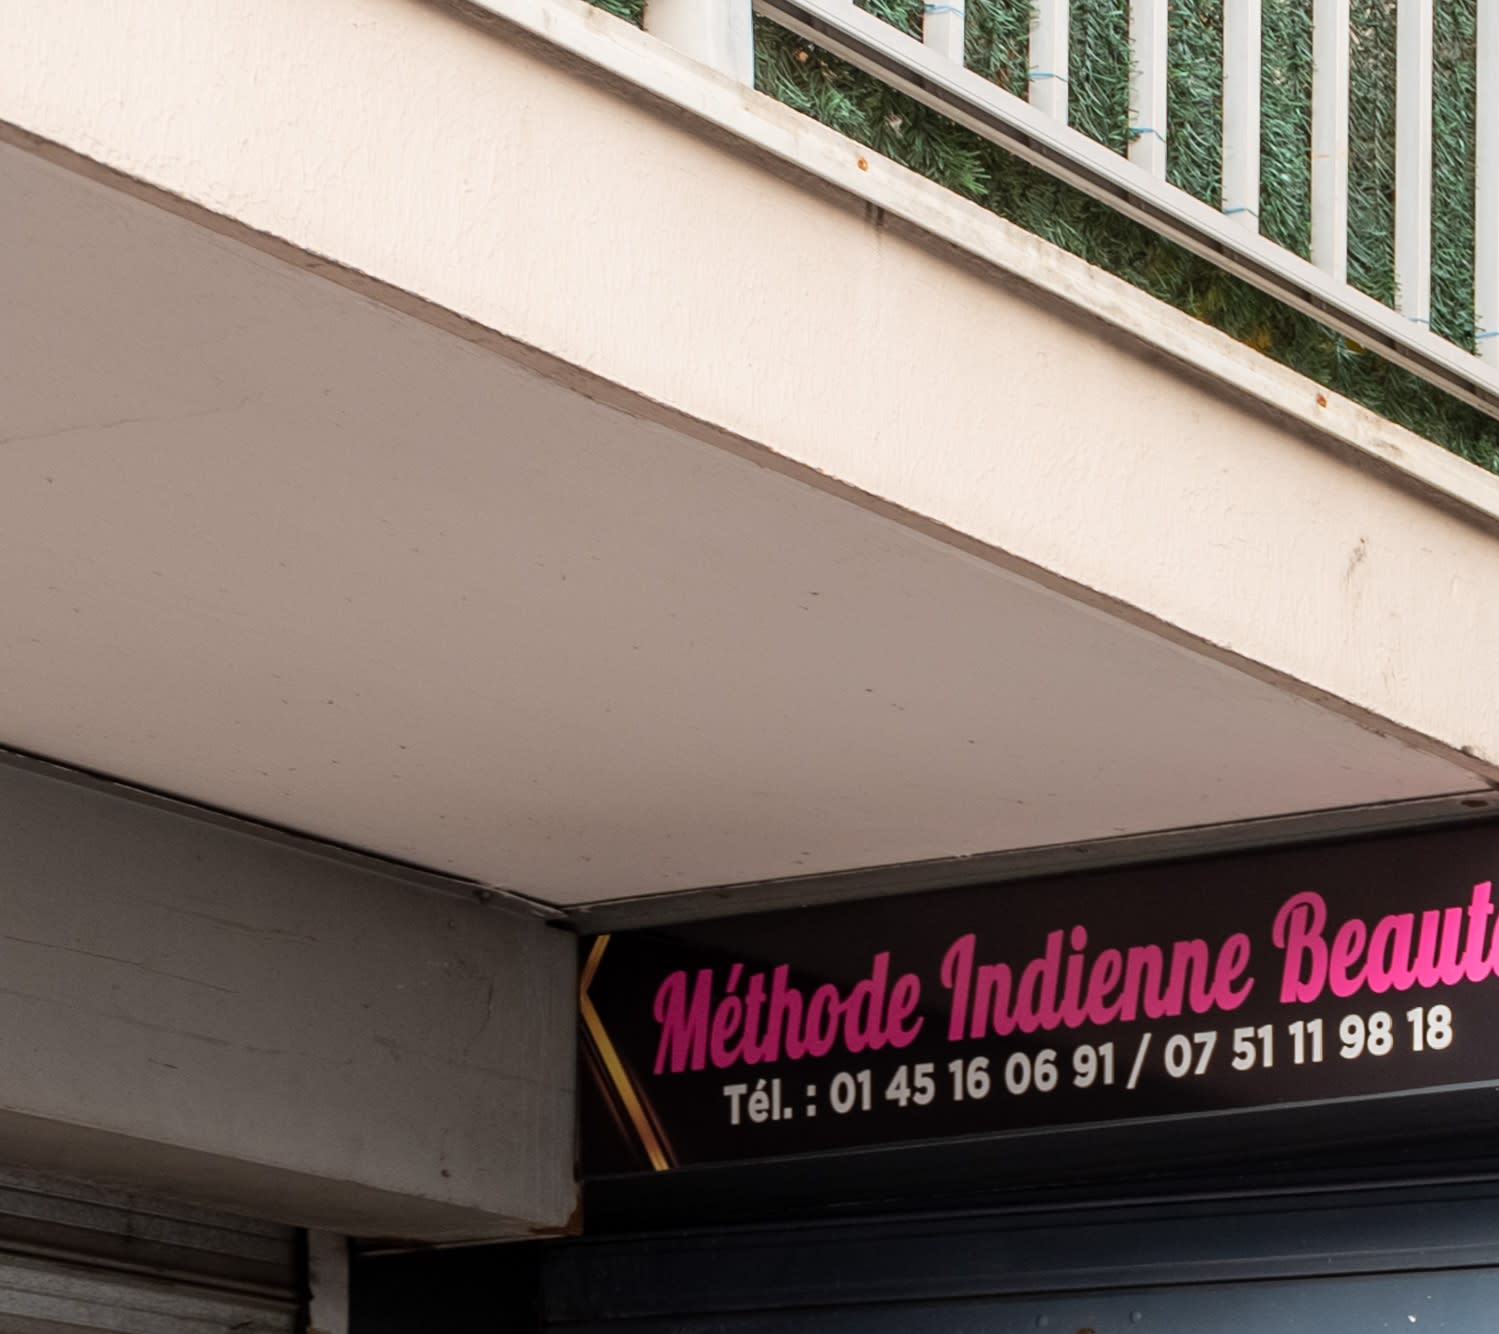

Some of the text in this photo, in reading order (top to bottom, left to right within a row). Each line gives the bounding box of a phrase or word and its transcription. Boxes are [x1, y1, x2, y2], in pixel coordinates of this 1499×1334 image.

[654, 952, 923, 1076] Méthode
[938, 924, 1256, 1042] Indienne
[723, 1081, 796, 1128] Tél.
[828, 1071, 875, 1115] 01
[885, 1064, 935, 1108] 45
[949, 1058, 990, 1100] 16
[1005, 1050, 1058, 1097] 06
[1071, 1044, 1115, 1089] 91
[1126, 1034, 1151, 1091] /
[1164, 1032, 1217, 1077] 07
[1231, 1026, 1273, 1070] 51
[1288, 1022, 1326, 1065] 11
[1340, 1015, 1394, 1060] 98
[1408, 1007, 1453, 1052] 18
